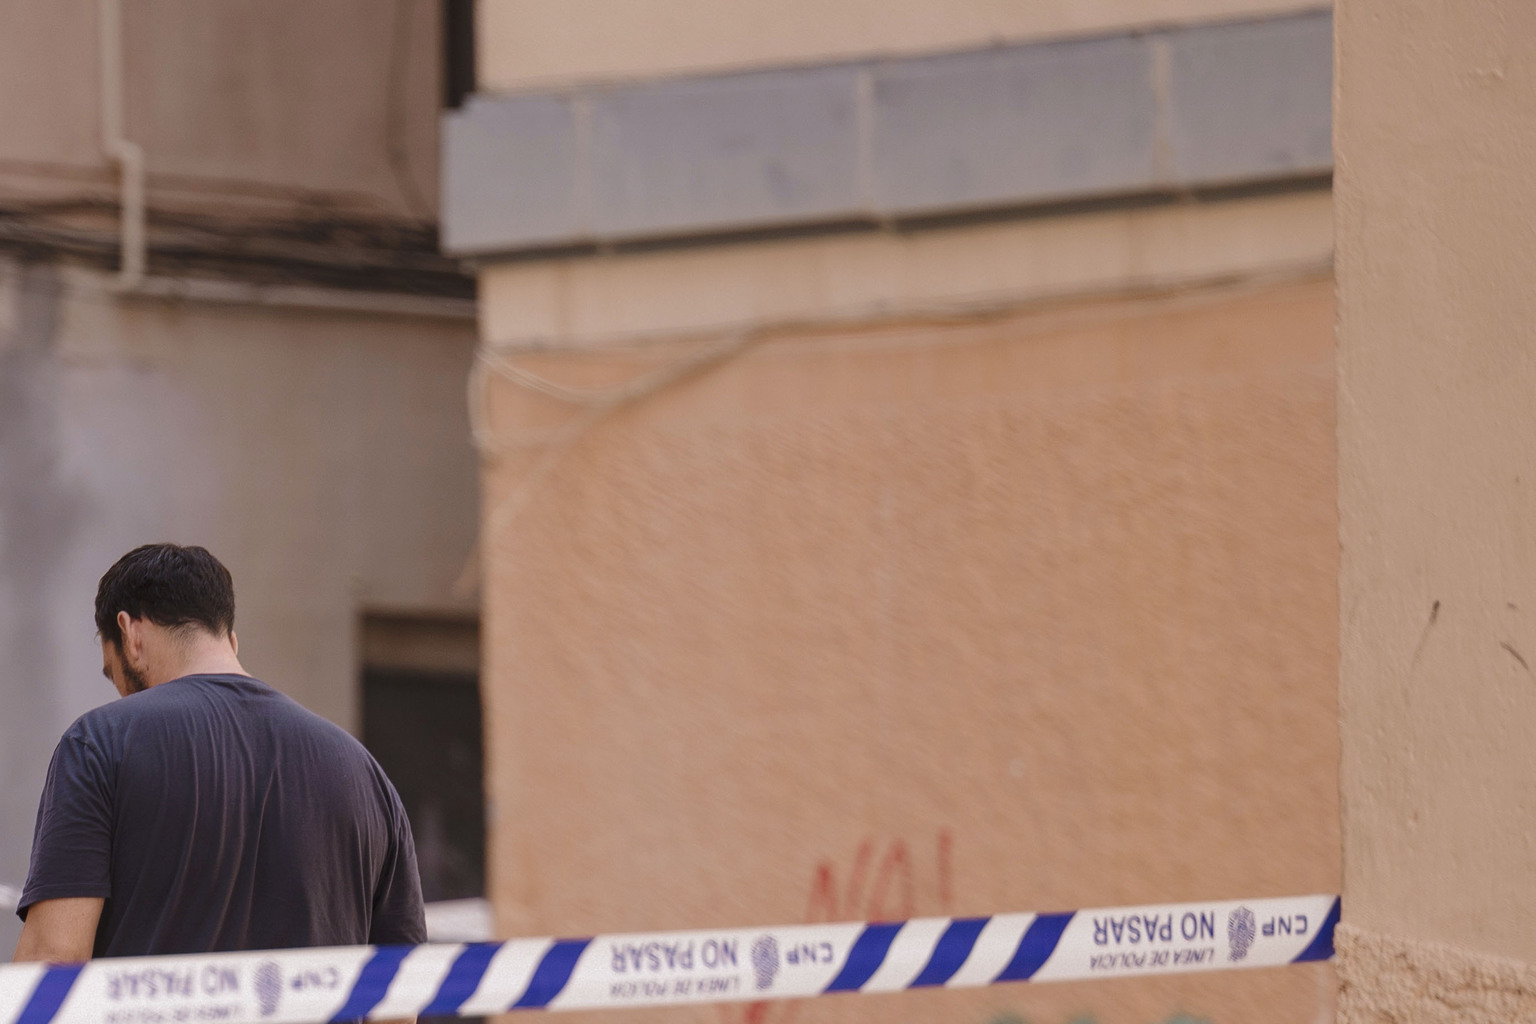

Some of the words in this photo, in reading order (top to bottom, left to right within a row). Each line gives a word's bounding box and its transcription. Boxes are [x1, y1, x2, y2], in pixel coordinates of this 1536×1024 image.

[1093, 913, 1172, 945] PASAR
[1181, 911, 1214, 942] NO
[1262, 915, 1308, 936] CNP
[610, 943, 692, 974] PASAR
[702, 938, 737, 970] NO
[786, 943, 833, 964] CNP
[1090, 952, 1144, 971] POLICIA
[1151, 950, 1169, 967] DE
[1173, 948, 1214, 966] LINEA
[107, 968, 192, 1001] PASAR
[203, 966, 238, 996] NO
[291, 967, 339, 990] CNP
